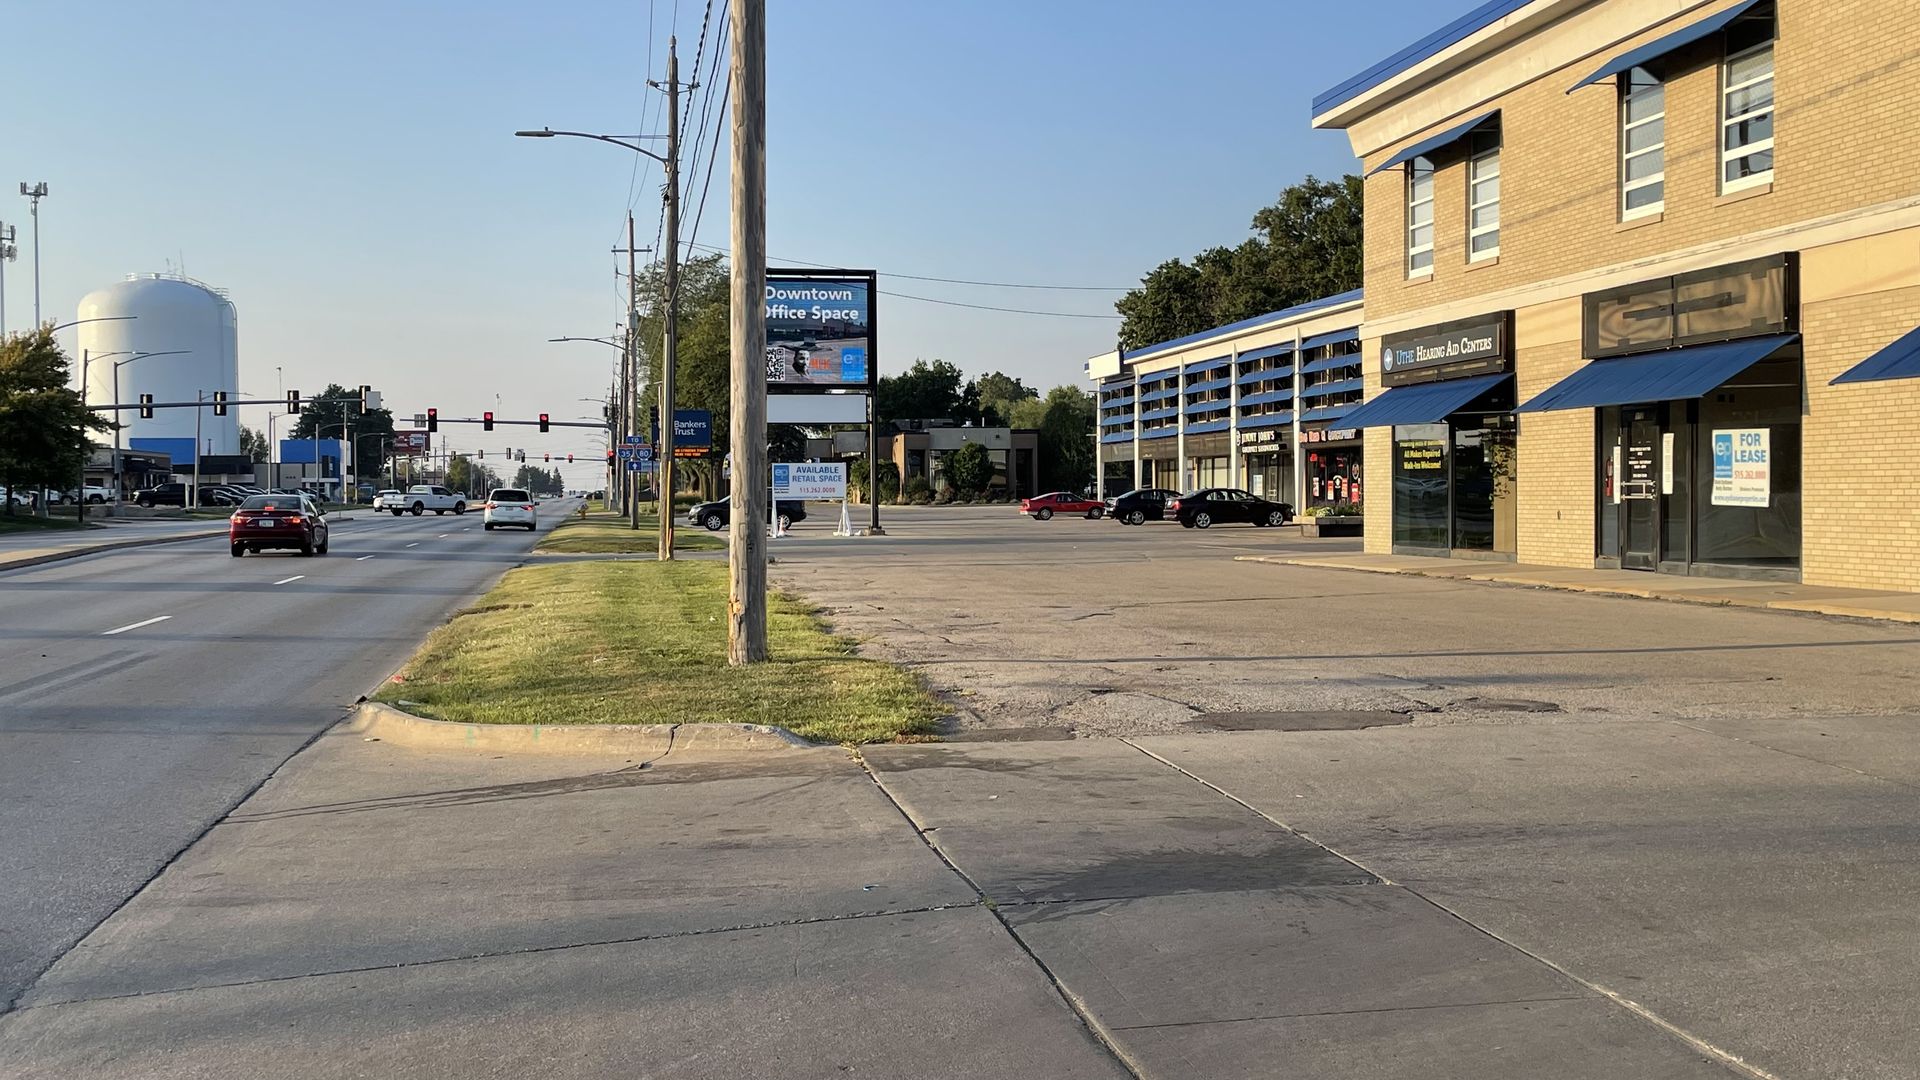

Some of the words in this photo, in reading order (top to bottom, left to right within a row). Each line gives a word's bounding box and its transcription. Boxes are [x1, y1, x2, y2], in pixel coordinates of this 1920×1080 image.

[765, 286, 852, 301] Downtown
[812, 305, 859, 323] Space
[1416, 345, 1445, 362] HEARING
[1446, 340, 1460, 357] AID
[1461, 337, 1492, 354] CENTERS
[673, 420, 707, 428] Bankers
[674, 428, 695, 436] Trust
[1740, 433, 1761, 446] FOR
[1734, 450, 1767, 463] LEASE
[796, 466, 839, 474] AVAILABLE
